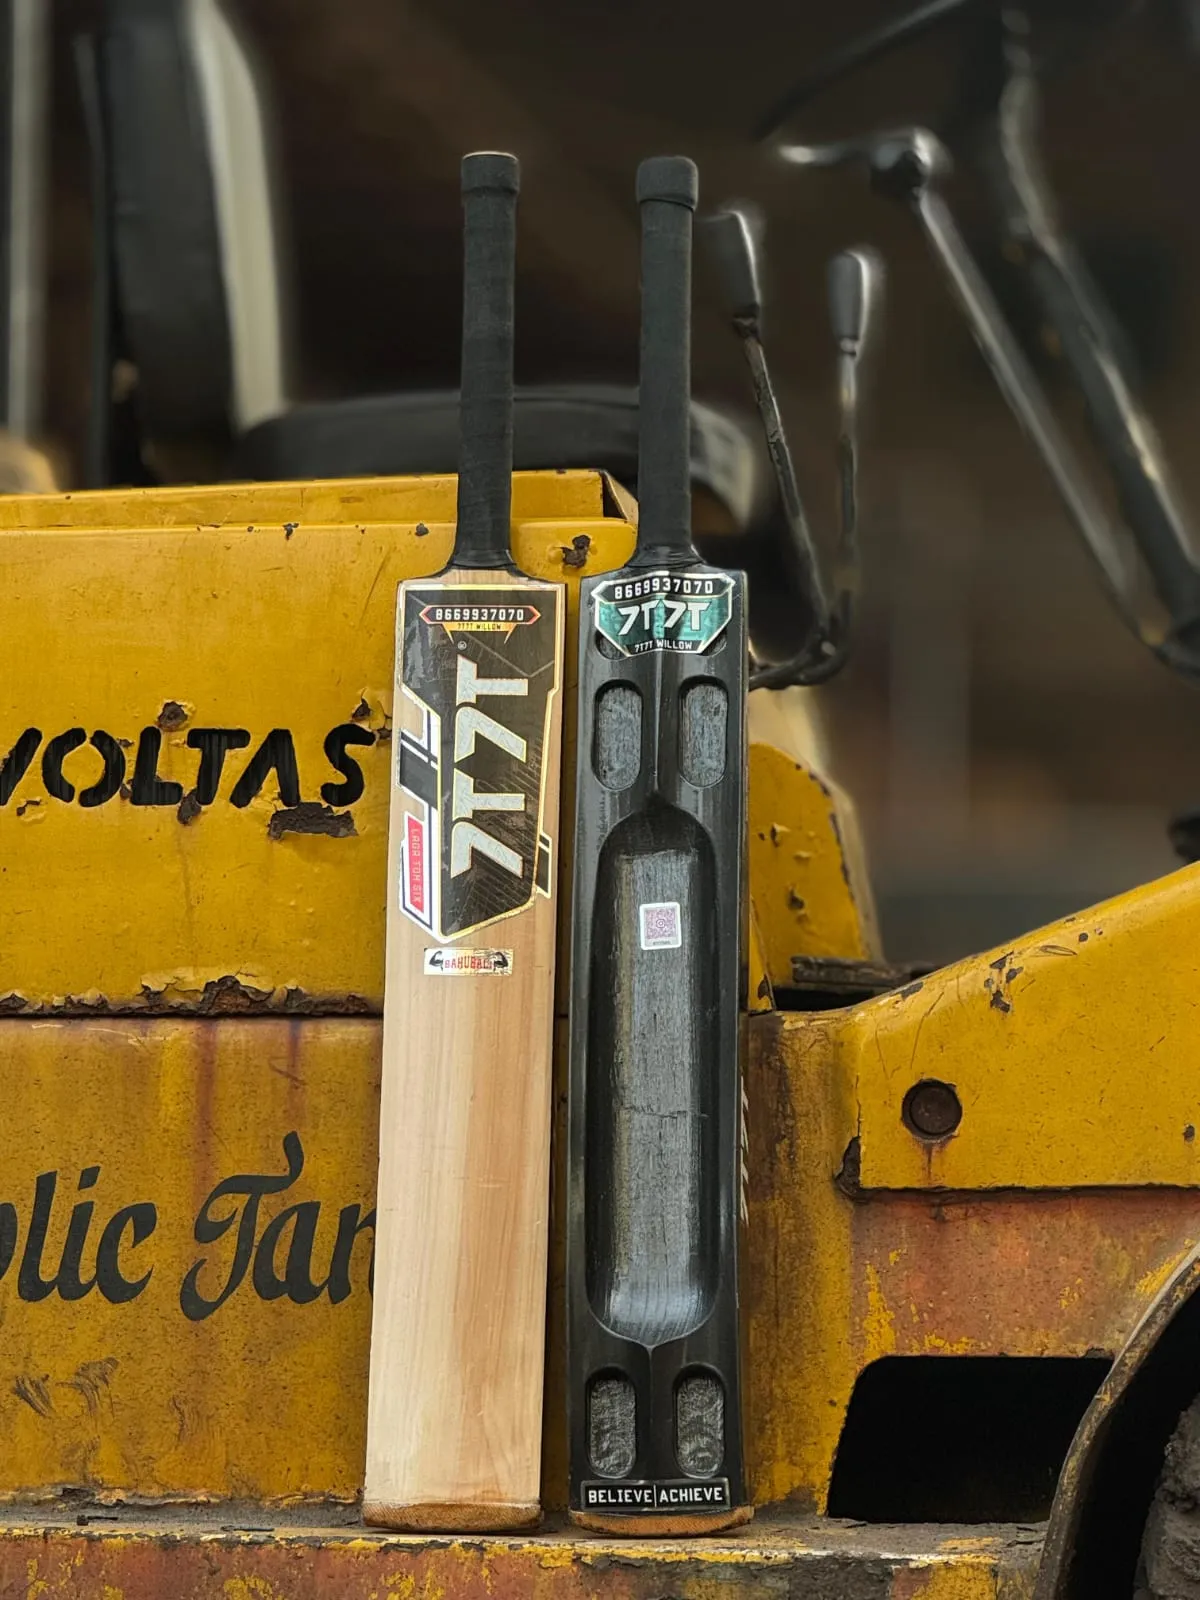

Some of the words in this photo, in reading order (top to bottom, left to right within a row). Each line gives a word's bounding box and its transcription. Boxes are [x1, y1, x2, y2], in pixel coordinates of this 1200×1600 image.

[614, 577, 714, 600] 8669937070
[435, 608, 524, 621] 8669937070
[617, 599, 712, 636] 7T7T
[634, 641, 653, 652] 7T7T
[656, 639, 693, 650] WILLOW
[450, 653, 529, 880] 7T7T
[412, 883, 422, 903] SIX
[588, 1489, 653, 1504] BELIEVE
[659, 1487, 723, 1503] ACHIEVE
